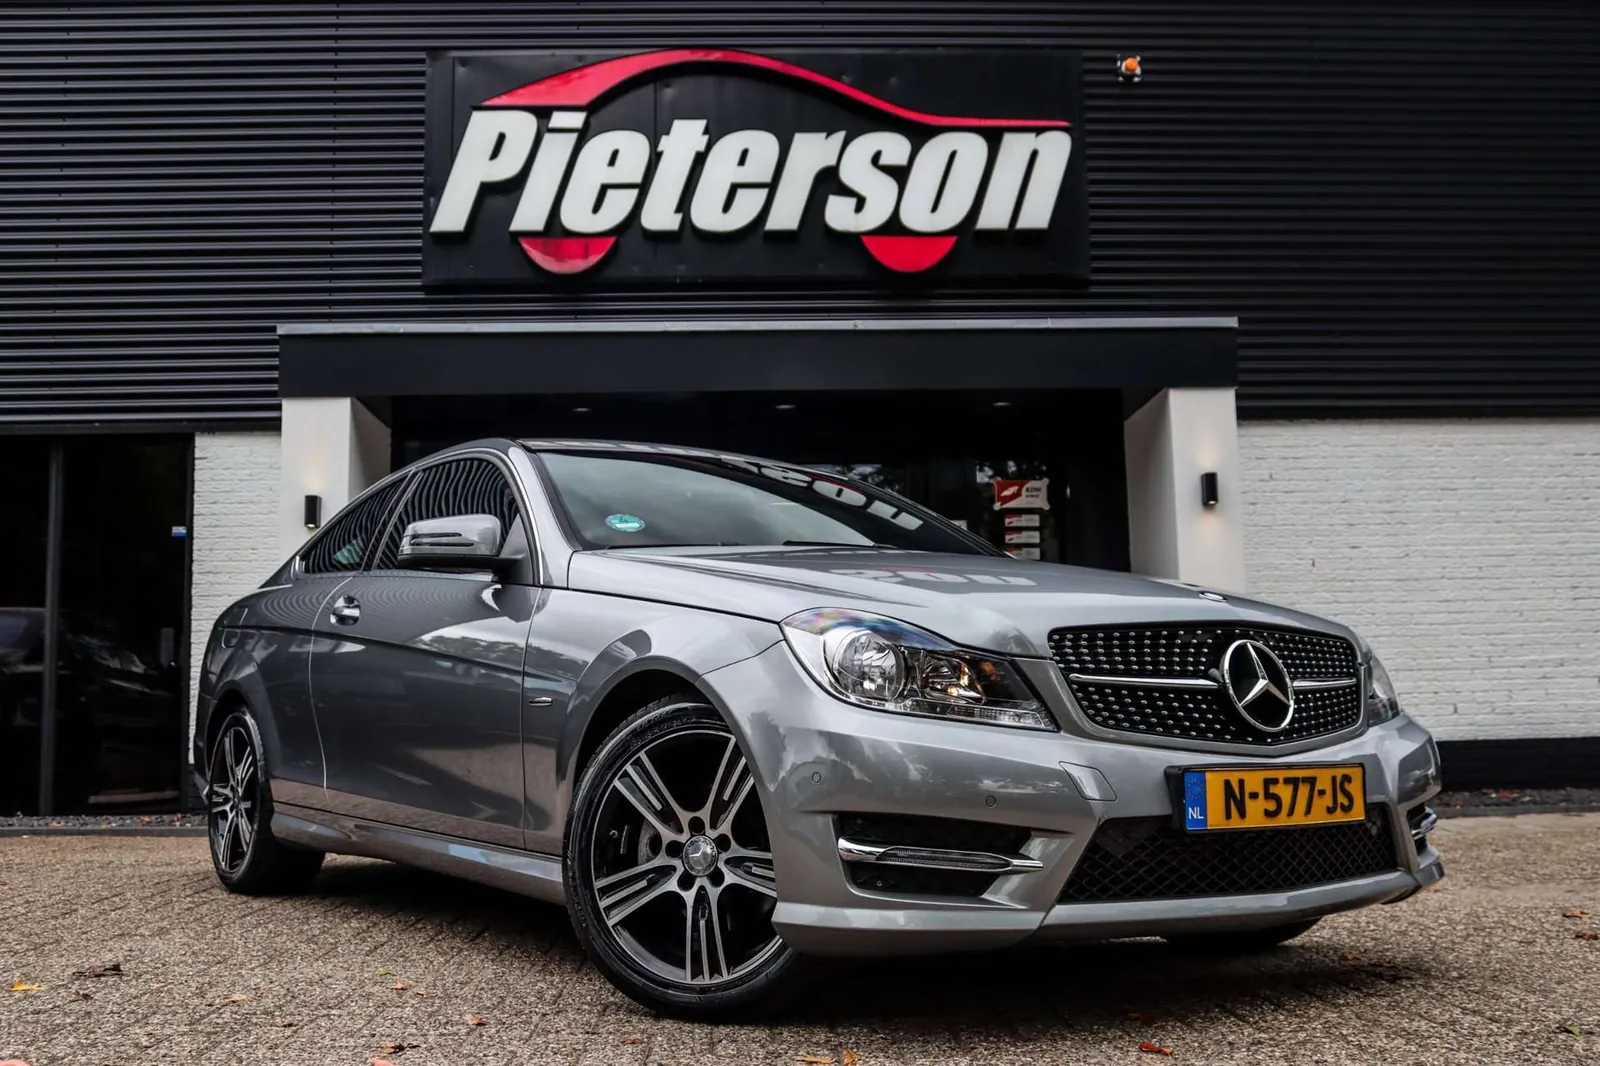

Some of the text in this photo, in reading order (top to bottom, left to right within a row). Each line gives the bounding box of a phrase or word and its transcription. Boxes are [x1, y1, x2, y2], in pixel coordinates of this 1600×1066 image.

[429, 110, 1072, 233] Pieterson
[1188, 806, 1204, 819] NL
[1223, 773, 1355, 821] N-577-JS
